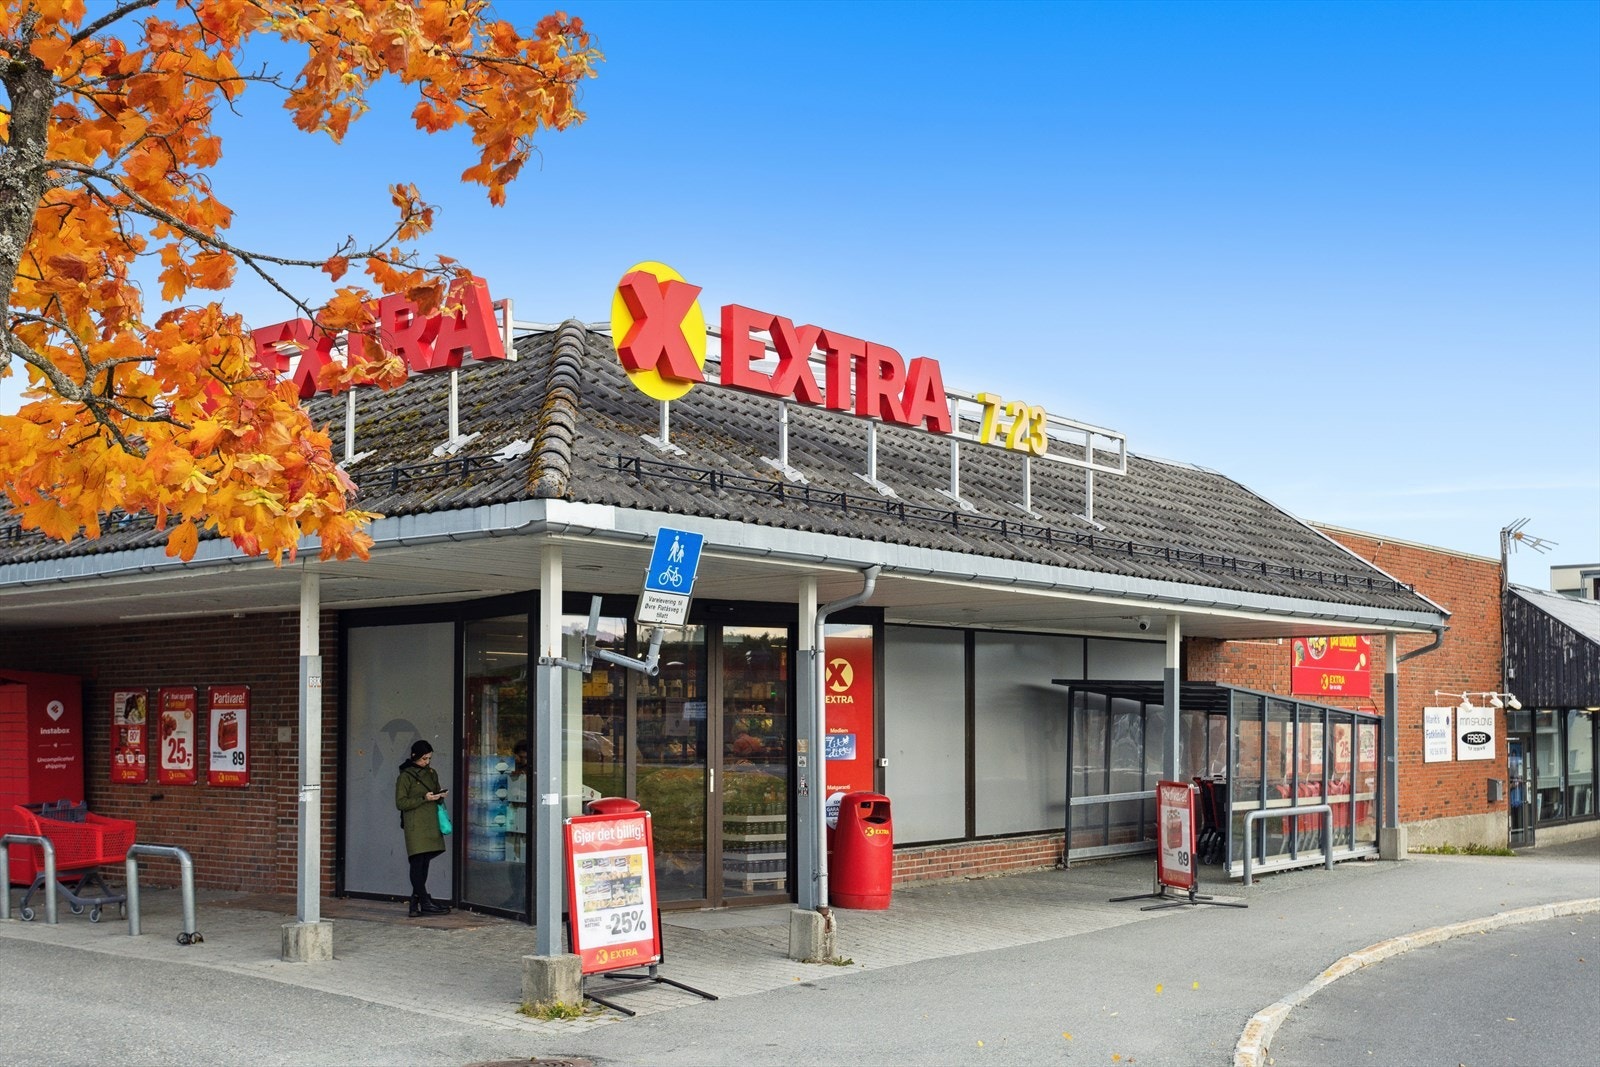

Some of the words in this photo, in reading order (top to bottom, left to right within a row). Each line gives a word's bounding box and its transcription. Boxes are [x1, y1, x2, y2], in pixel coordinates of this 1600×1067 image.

[721, 303, 953, 434] EXTRA
[977, 391, 1048, 458] 7-23
[648, 595, 677, 606] Varelevering
[1329, 675, 1346, 684] EXTRA
[213, 692, 246, 704] Partivare!
[826, 695, 854, 704] EXTRA
[40, 727, 71, 735] instabox
[232, 751, 245, 766] 89
[827, 784, 851, 792] Matgaranti
[574, 829, 595, 846] Gjør
[598, 828, 615, 841] det
[616, 823, 645, 840] billig!
[1178, 850, 1189, 867] 89
[610, 947, 639, 960] EXTRA
